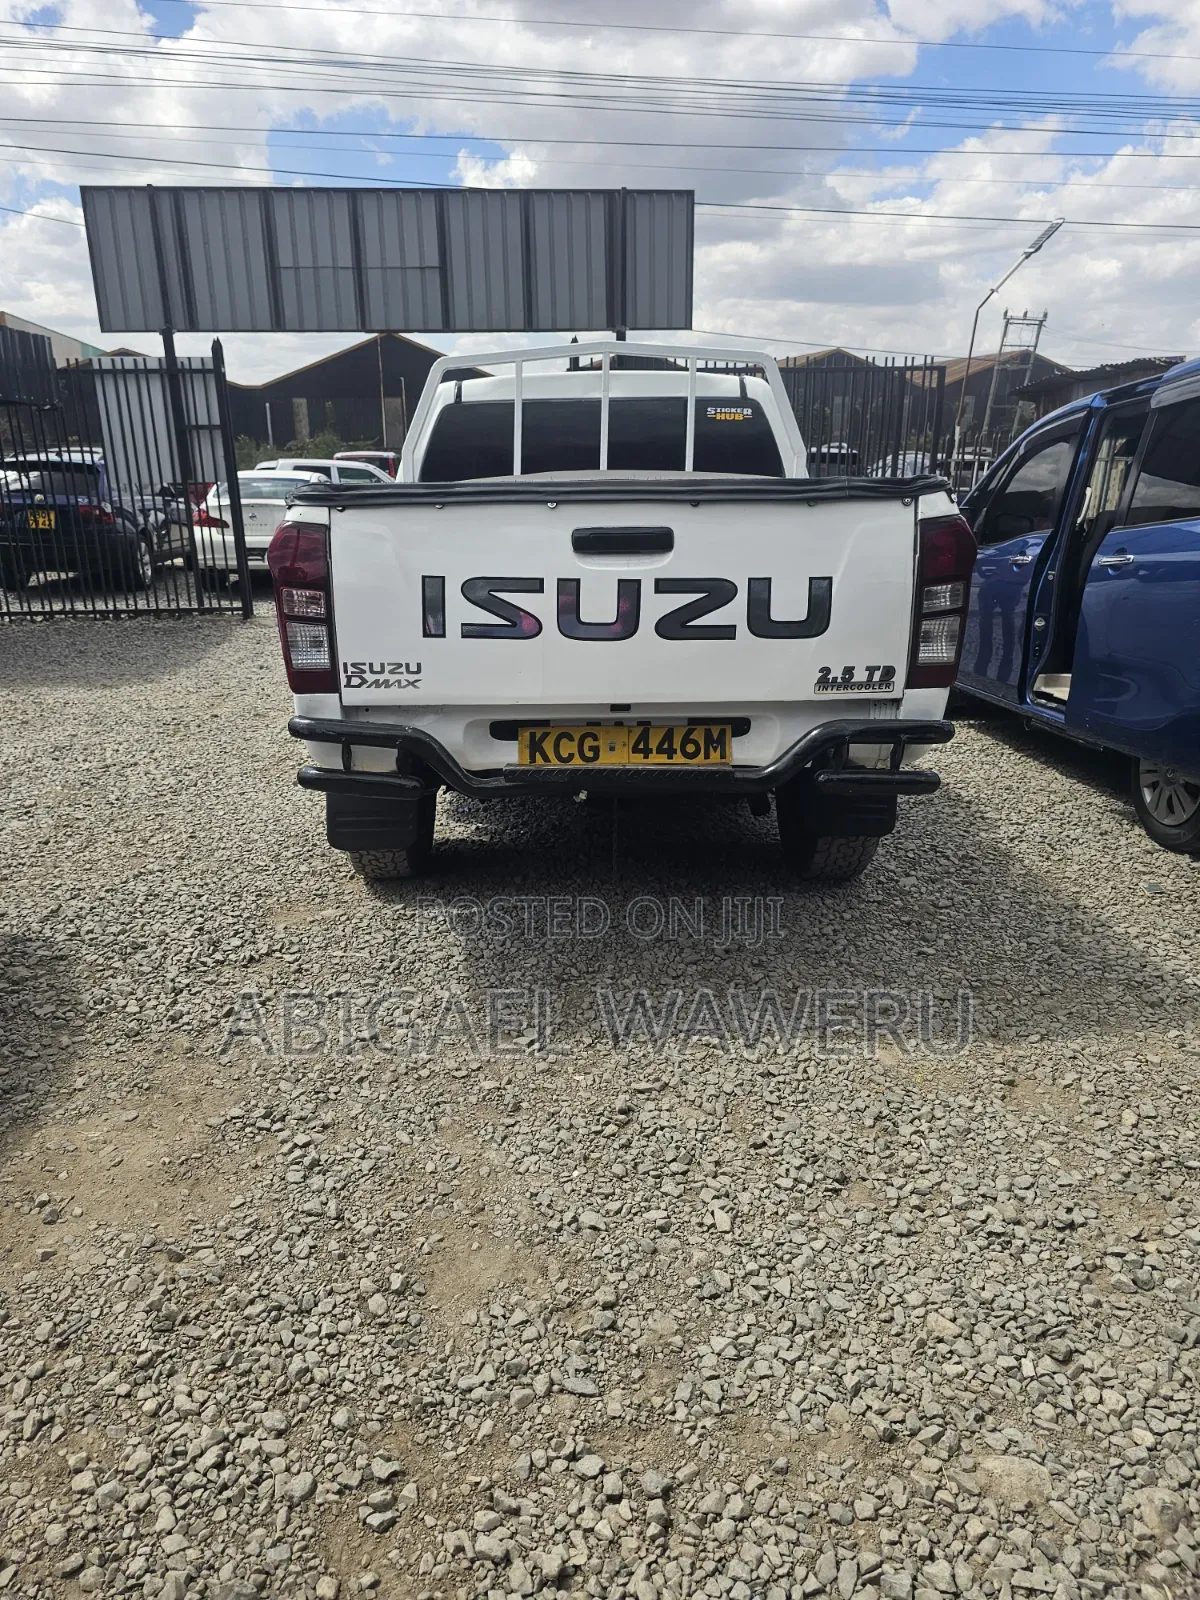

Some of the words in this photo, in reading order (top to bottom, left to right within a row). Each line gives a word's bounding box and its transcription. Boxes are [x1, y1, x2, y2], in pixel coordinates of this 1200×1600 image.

[706, 407, 752, 415] STICKER
[422, 575, 833, 641] ISUZU
[342, 661, 422, 675] ISUZU
[816, 665, 856, 683] 2.5
[864, 665, 897, 682] TD
[816, 682, 892, 692] INTERCOOLER
[528, 730, 601, 764] KCG
[631, 726, 727, 760] 446M
